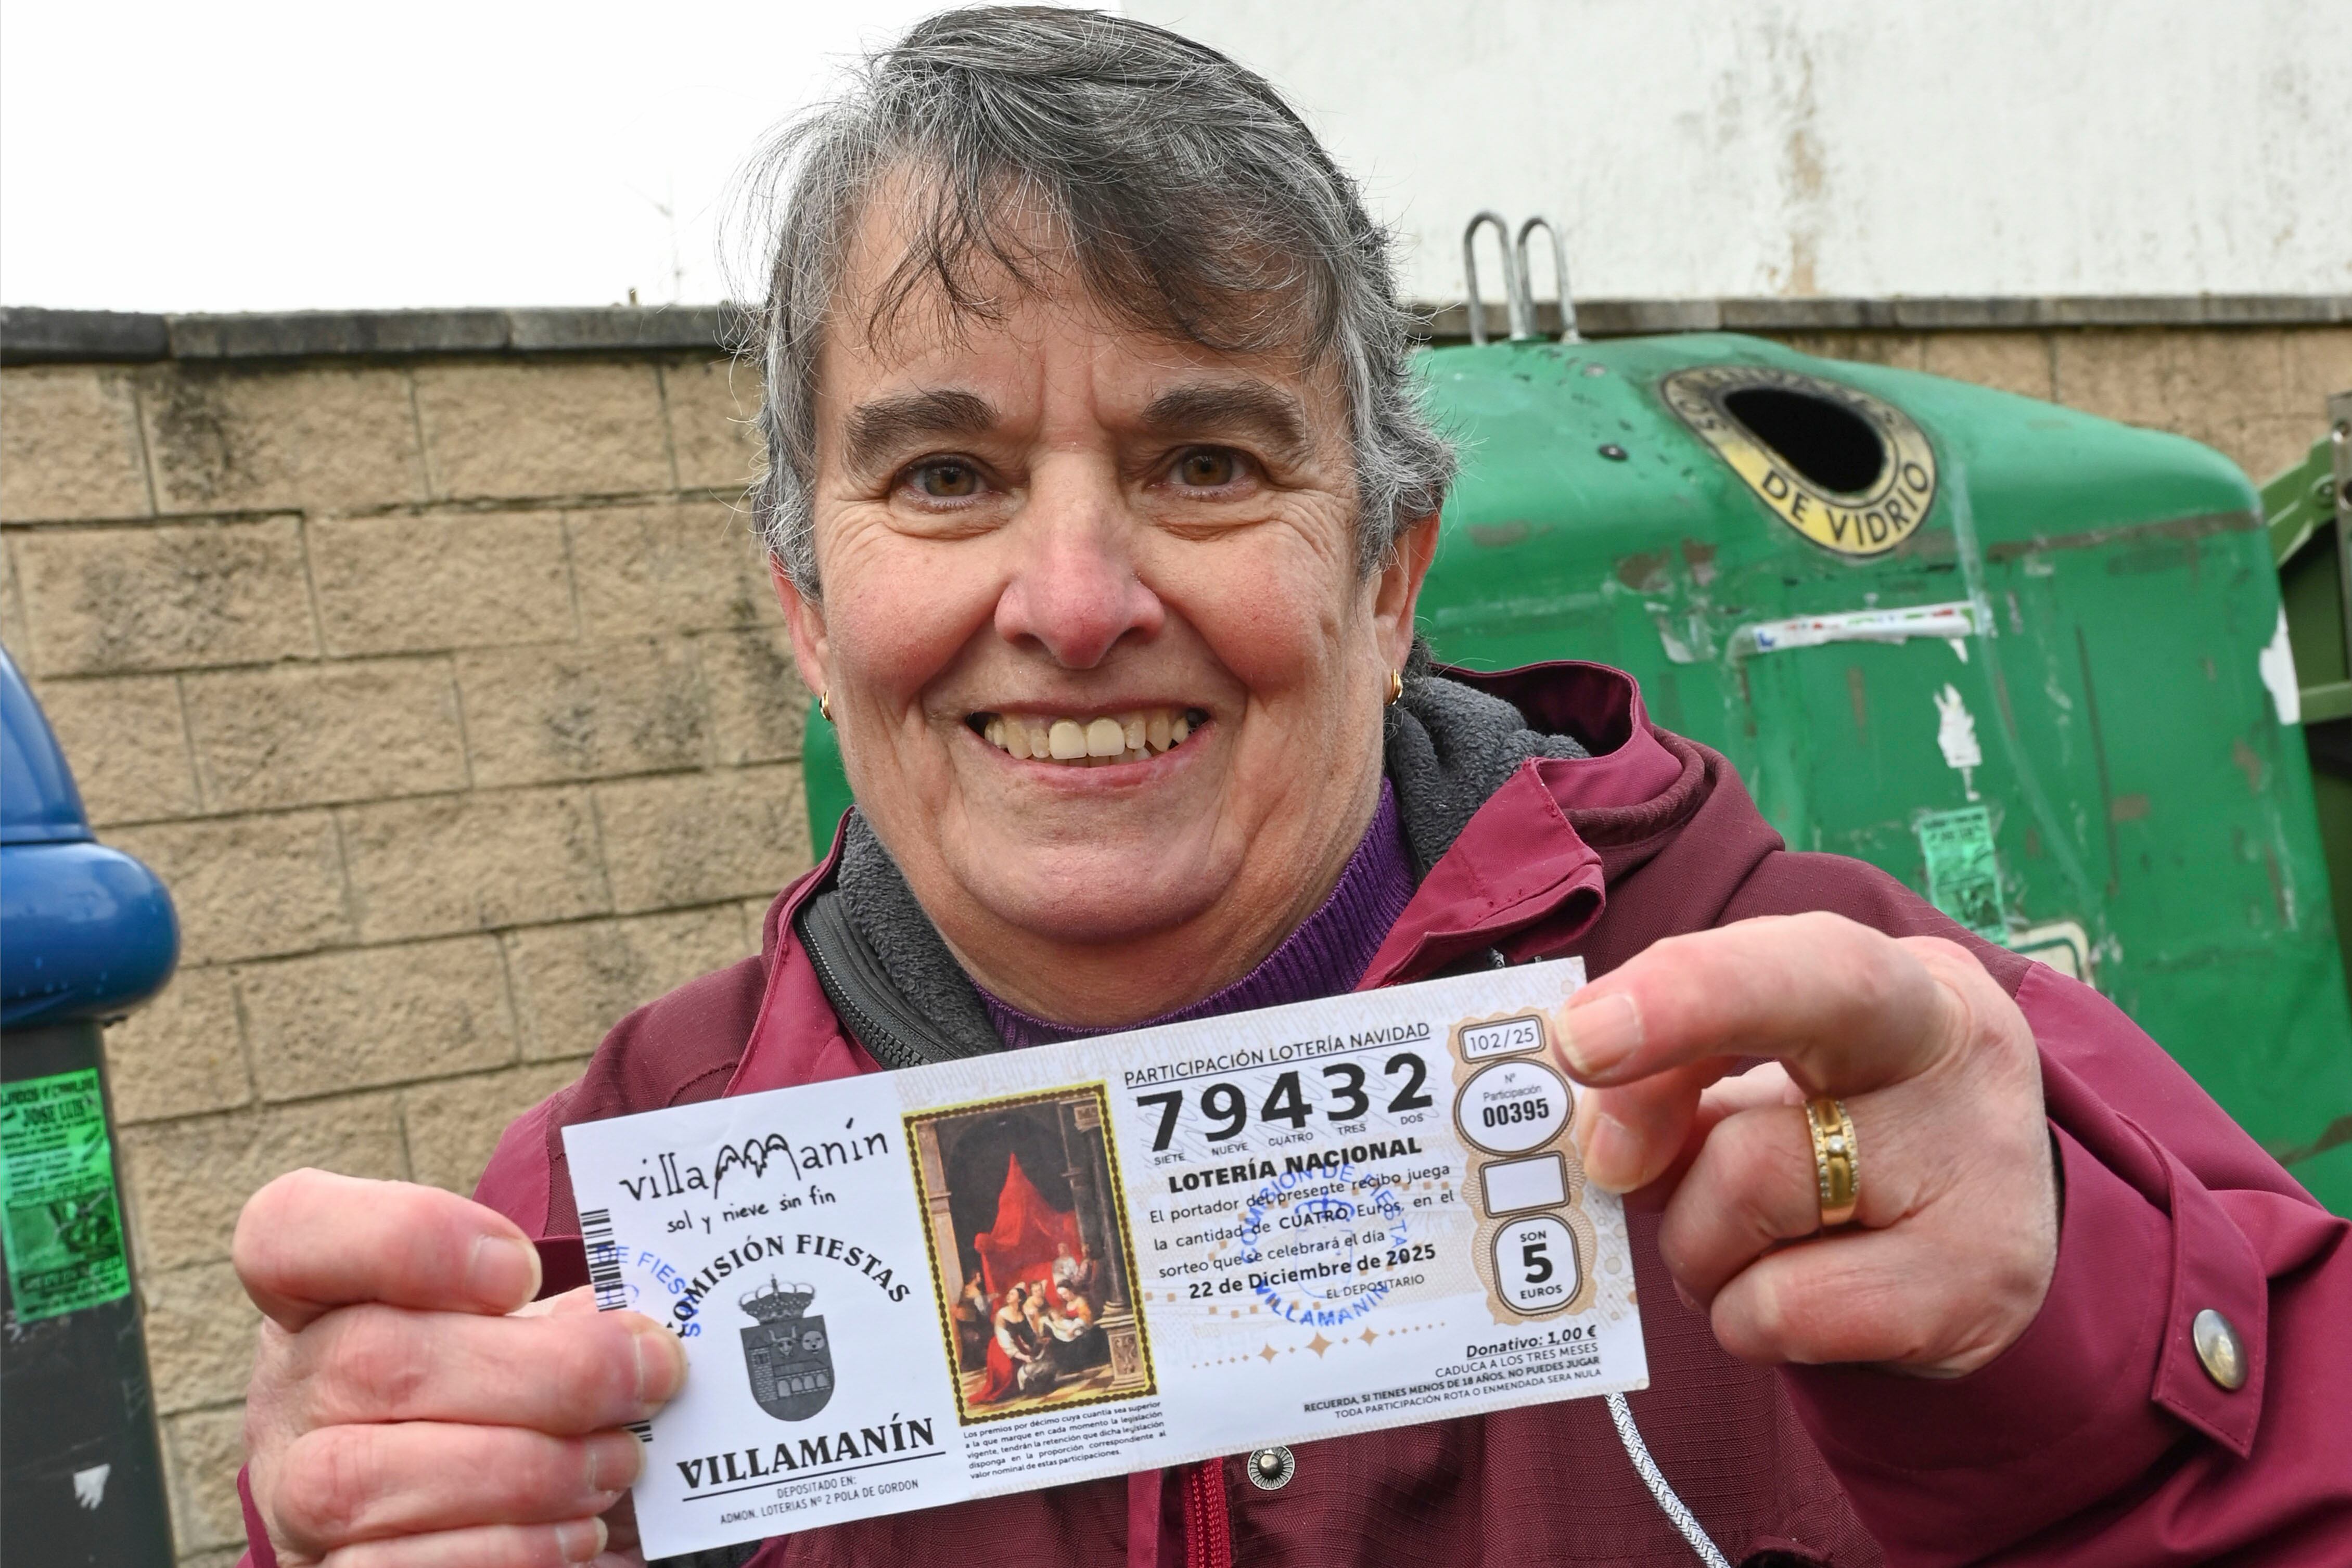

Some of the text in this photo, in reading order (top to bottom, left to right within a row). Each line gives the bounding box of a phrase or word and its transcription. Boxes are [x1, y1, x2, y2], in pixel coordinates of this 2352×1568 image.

[1761, 462, 1928, 545] DE VIDRIO
[1124, 1022, 1429, 1086] PARTICIPACIÓN LOTERÍA NAVIDAD
[1470, 1027, 1535, 1051] 102/25
[1136, 1052, 1433, 1152] 79432
[1483, 1084, 1542, 1102] Participación
[1483, 1098, 1549, 1127] 00395
[1154, 1113, 1424, 1166] SIETE NUEVE CUATRO TRES DOS
[1168, 1137, 1422, 1193] LOTERÍA NACIONAL
[1322, 1163, 1355, 1183] DE
[668, 1185, 836, 1235] sol y nieve sin fin
[1149, 1165, 1450, 1224] El portador del presente recibo juega
[1154, 1189, 1454, 1251] la cantidad de CUATRO Euros, en el
[1520, 1230, 1547, 1242] SON
[796, 1234, 911, 1304] FIESTAS
[1159, 1230, 1385, 1278] sorteo que se celebrará el día
[1189, 1243, 1436, 1299] 22 de Diciembre de 2025
[1522, 1242, 1553, 1284] 5
[1326, 1274, 1425, 1299] EL DEPOSITARIO
[1520, 1284, 1563, 1300] EUROS
[1435, 1342, 1599, 1378] CADUCA A LOS TRES MESES
[1466, 1325, 1596, 1358] Donativo: 1,00 €
[1304, 1396, 1360, 1412] RECUERDA,
[1361, 1394, 1371, 1403] SI
[1372, 1387, 1407, 1400] TIENES
[1409, 1381, 1445, 1395] MENOS
[1447, 1379, 1460, 1389] DE
[1462, 1377, 1474, 1386] 18
[1507, 1368, 1524, 1378] NO
[1525, 1361, 1564, 1375] PUEDES
[1566, 1356, 1600, 1369] JUGAR
[1335, 1369, 1601, 1419] TODA PARTICIPACIÓN ROTA O ENMENDADA SERA NULA
[967, 1449, 999, 1459] vigente,
[1001, 1443, 1032, 1453] tendrán
[1042, 1435, 1081, 1446] retención
[1099, 1429, 1121, 1437] dicha
[1122, 1421, 1165, 1434] legislación
[979, 1426, 1013, 1437] premios
[1014, 1423, 1028, 1432] por
[1030, 1418, 1060, 1428] décimo
[1082, 1409, 1112, 1419] cuantía
[1128, 1402, 1160, 1412] superior
[982, 1438, 998, 1447] que
[1001, 1433, 1032, 1442] marque
[1047, 1426, 1066, 1435] cada
[1069, 1420, 1109, 1431] momento
[1120, 1411, 1162, 1423] legislación
[676, 1412, 934, 1489] VILLAMANÍN
[969, 1458, 1006, 1469] disponga
[1039, 1445, 1084, 1458] proporción
[1089, 1433, 1154, 1449] correspondiente
[992, 1464, 1025, 1475] nominal
[1058, 1449, 1122, 1466] participaciones.
[721, 1479, 918, 1524] ADMON. LOTERIAS Nº 2 POLA DE GORDON
[777, 1476, 857, 1499] DEPOSITADO EN:
